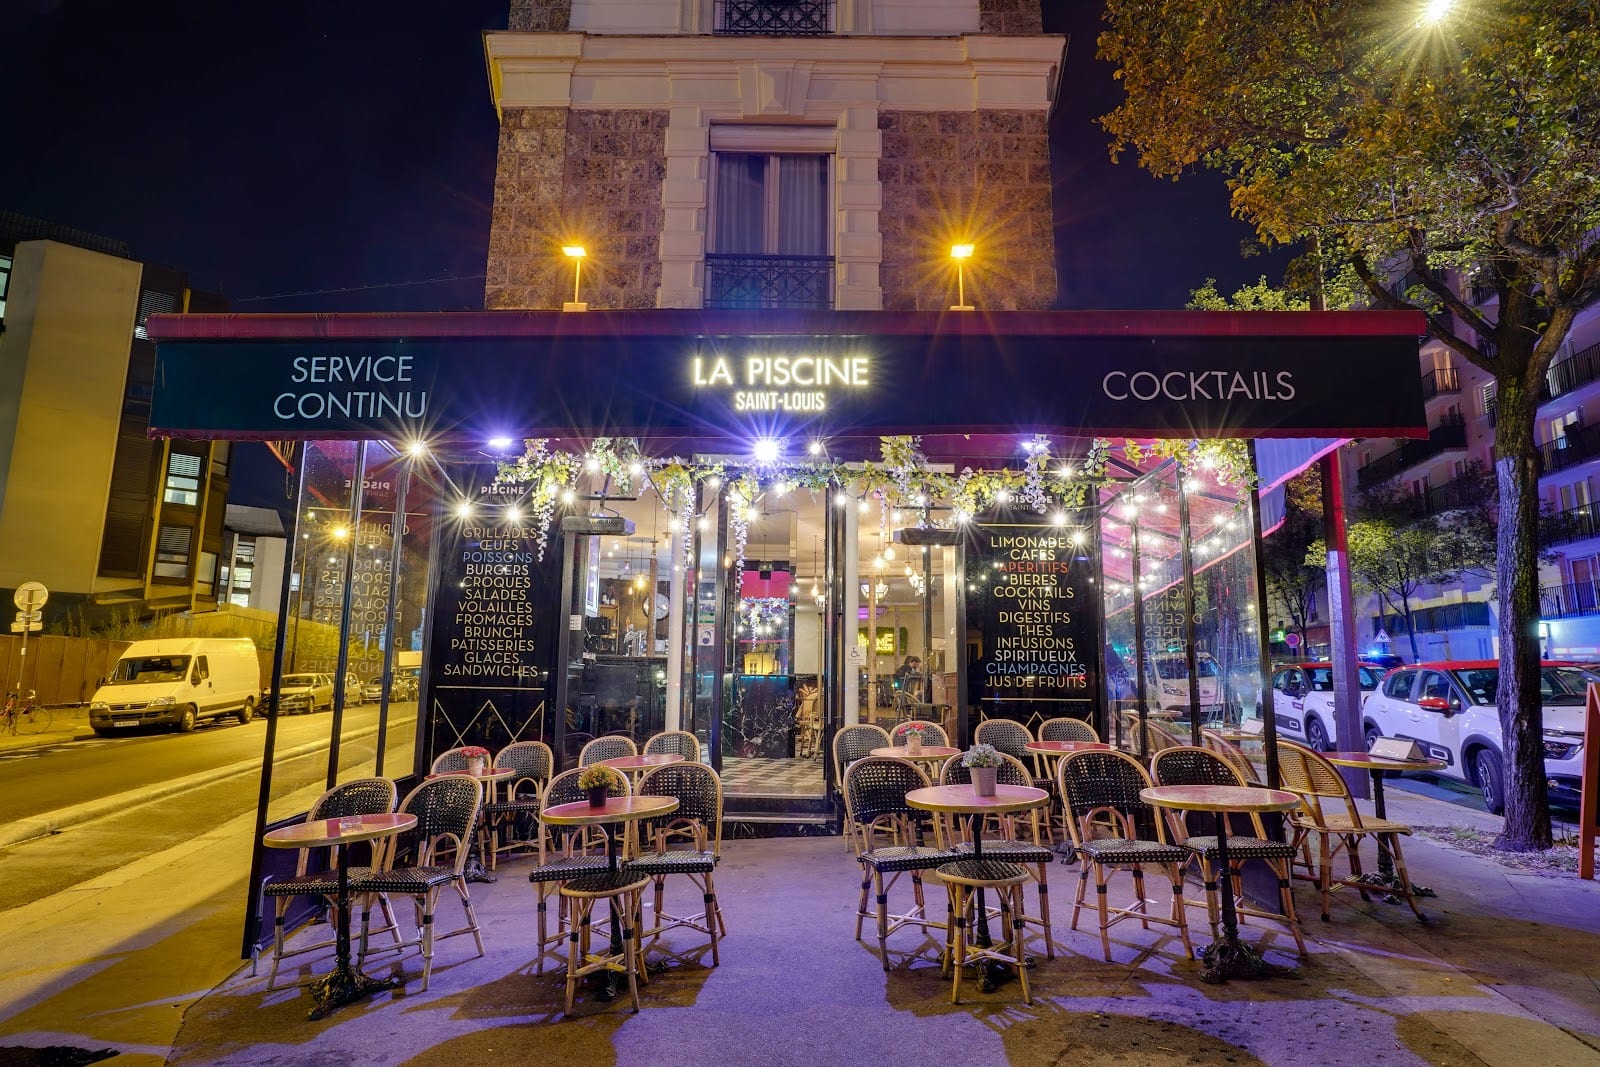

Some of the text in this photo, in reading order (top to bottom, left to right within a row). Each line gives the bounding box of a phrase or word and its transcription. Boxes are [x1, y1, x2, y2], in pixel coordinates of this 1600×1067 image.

[291, 356, 413, 383] SERVICE
[694, 357, 868, 385] LA PISCINE
[1102, 371, 1296, 400] COCKTAILS
[273, 391, 426, 419] CONTINU
[735, 392, 825, 410] SAINT-LOUIS
[481, 486, 525, 495] PISCINE
[462, 528, 537, 539] GRILLADES
[479, 540, 519, 551] ŒUFS
[991, 536, 1074, 549] LIMONADES
[463, 552, 533, 563] POISSONS
[1010, 549, 1056, 561] CAFES
[466, 564, 529, 576] BURGERS
[999, 562, 1068, 573] APERITIFS
[462, 576, 531, 588] CROQUES
[1010, 574, 1057, 586] BIERES
[465, 589, 526, 600] SALADES
[993, 587, 1074, 599] COCKTAILS
[458, 601, 532, 613] VOLAILLES
[1018, 600, 1051, 611] VINS
[456, 614, 533, 626] FROMAGES
[999, 612, 1071, 624] DIGESTIFS
[464, 627, 523, 638] BRUNCH
[1017, 624, 1053, 636] THES
[451, 639, 534, 651] PATISSERIES
[997, 637, 1074, 649] INFUSIONS
[464, 652, 520, 664] GLACES
[994, 650, 1076, 662] SPIRITUEUX
[443, 664, 538, 677] SANDWICHES
[986, 663, 1087, 675] CHAMPAGNES
[985, 676, 1087, 688] JUS DE FRUITS
